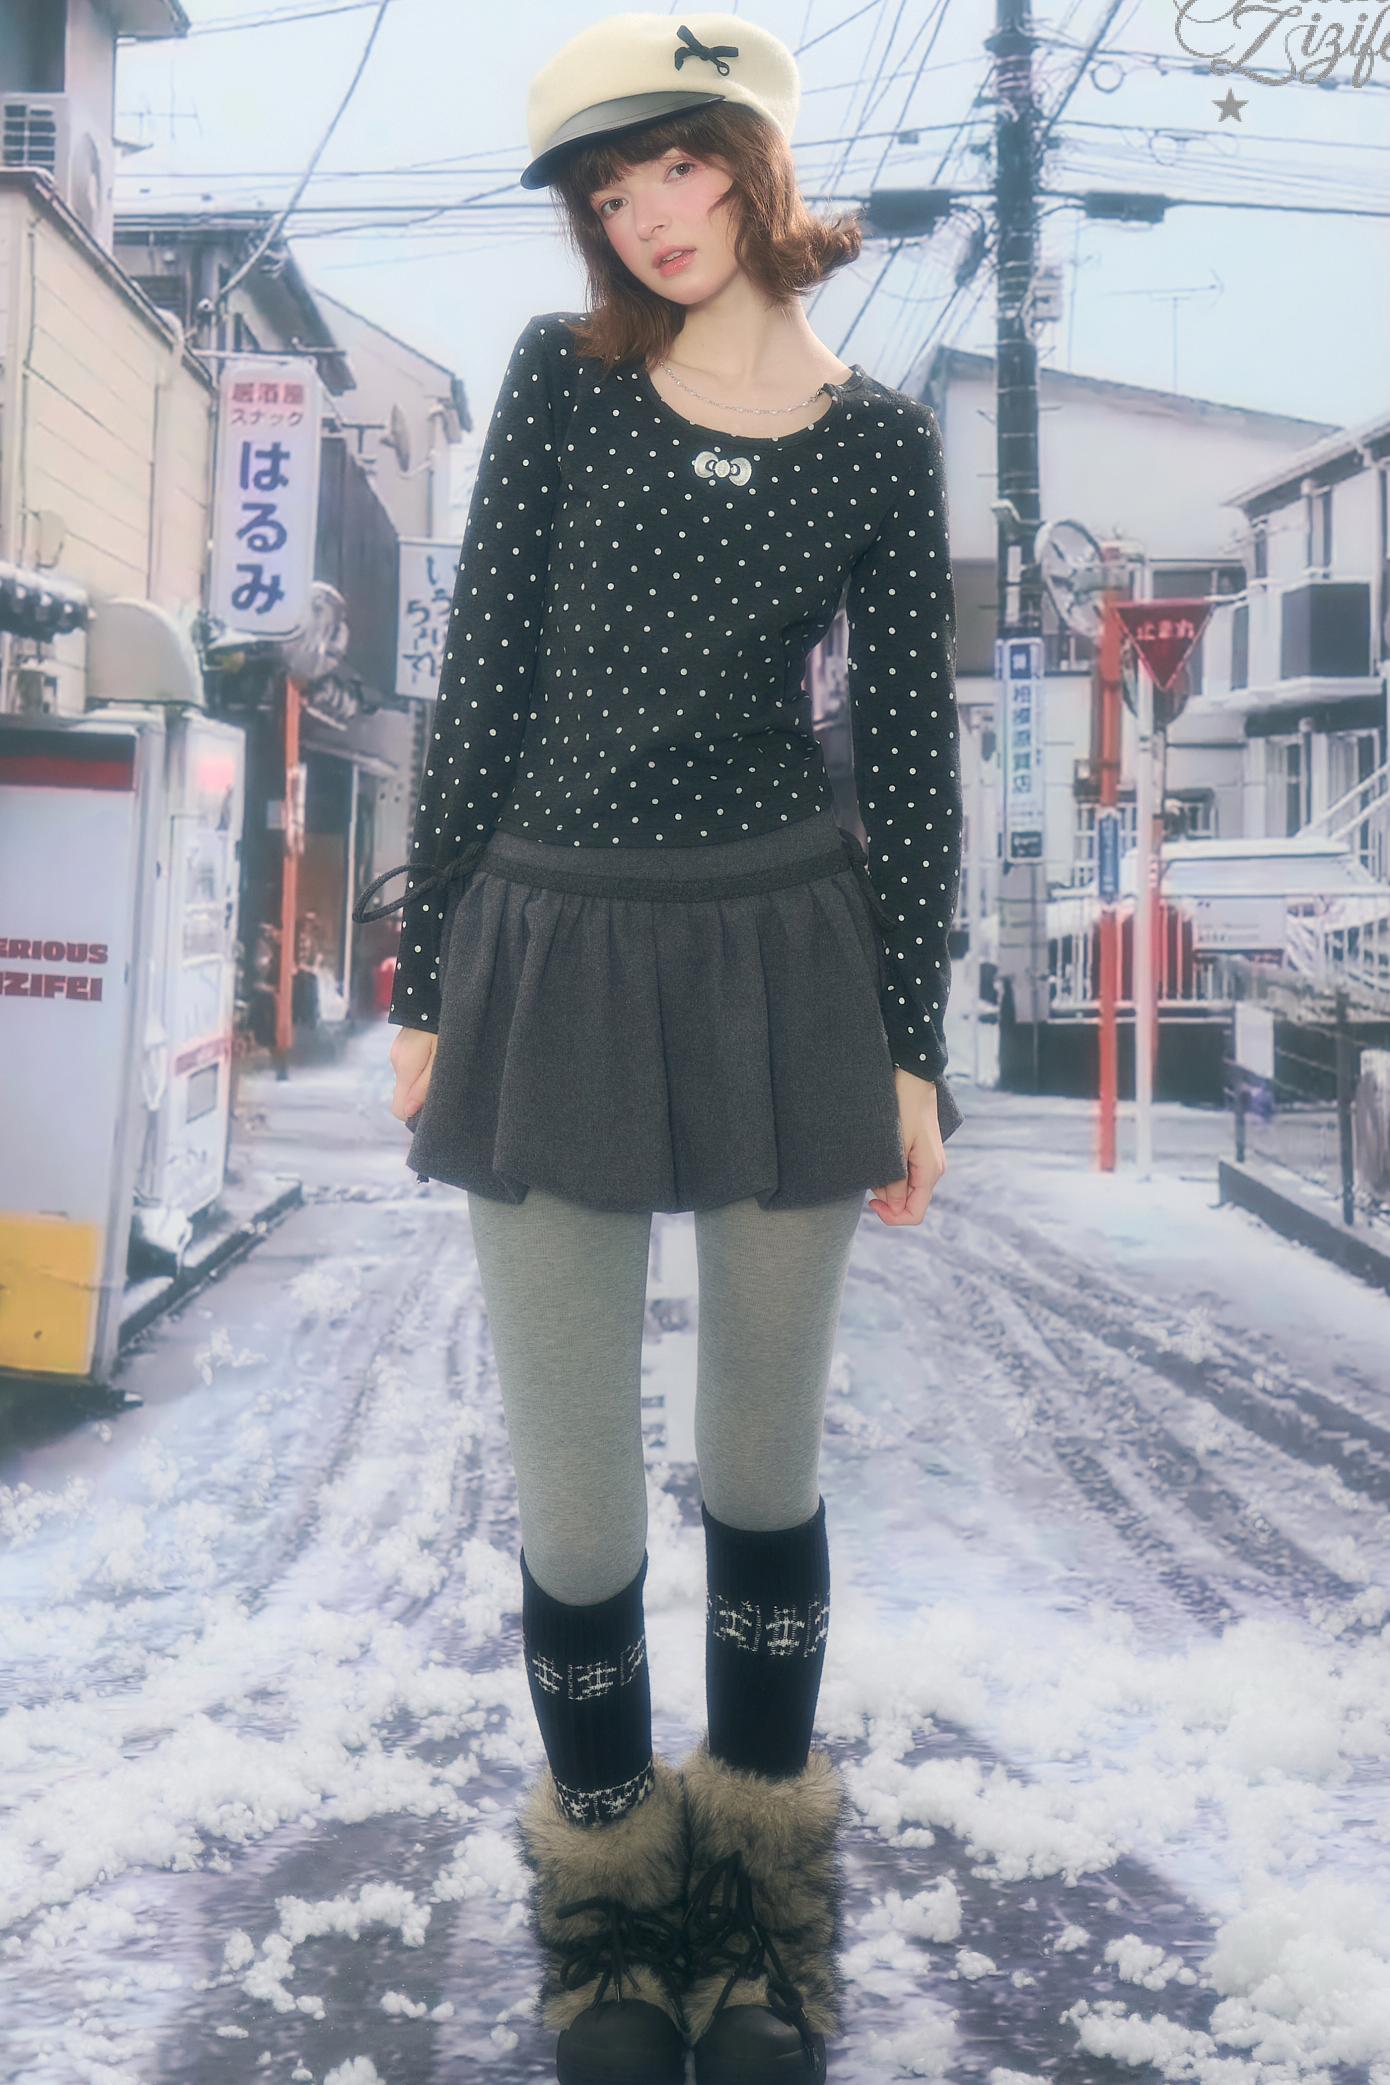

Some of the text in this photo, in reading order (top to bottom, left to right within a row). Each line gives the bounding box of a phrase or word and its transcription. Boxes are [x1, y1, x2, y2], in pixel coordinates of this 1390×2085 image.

[231, 382, 305, 404] 居酒屋
[230, 410, 304, 427] スナック
[230, 440, 291, 616] はるみ
[1136, 619, 1195, 641] 止まれ
[0, 970, 103, 1003] ZIFEI
